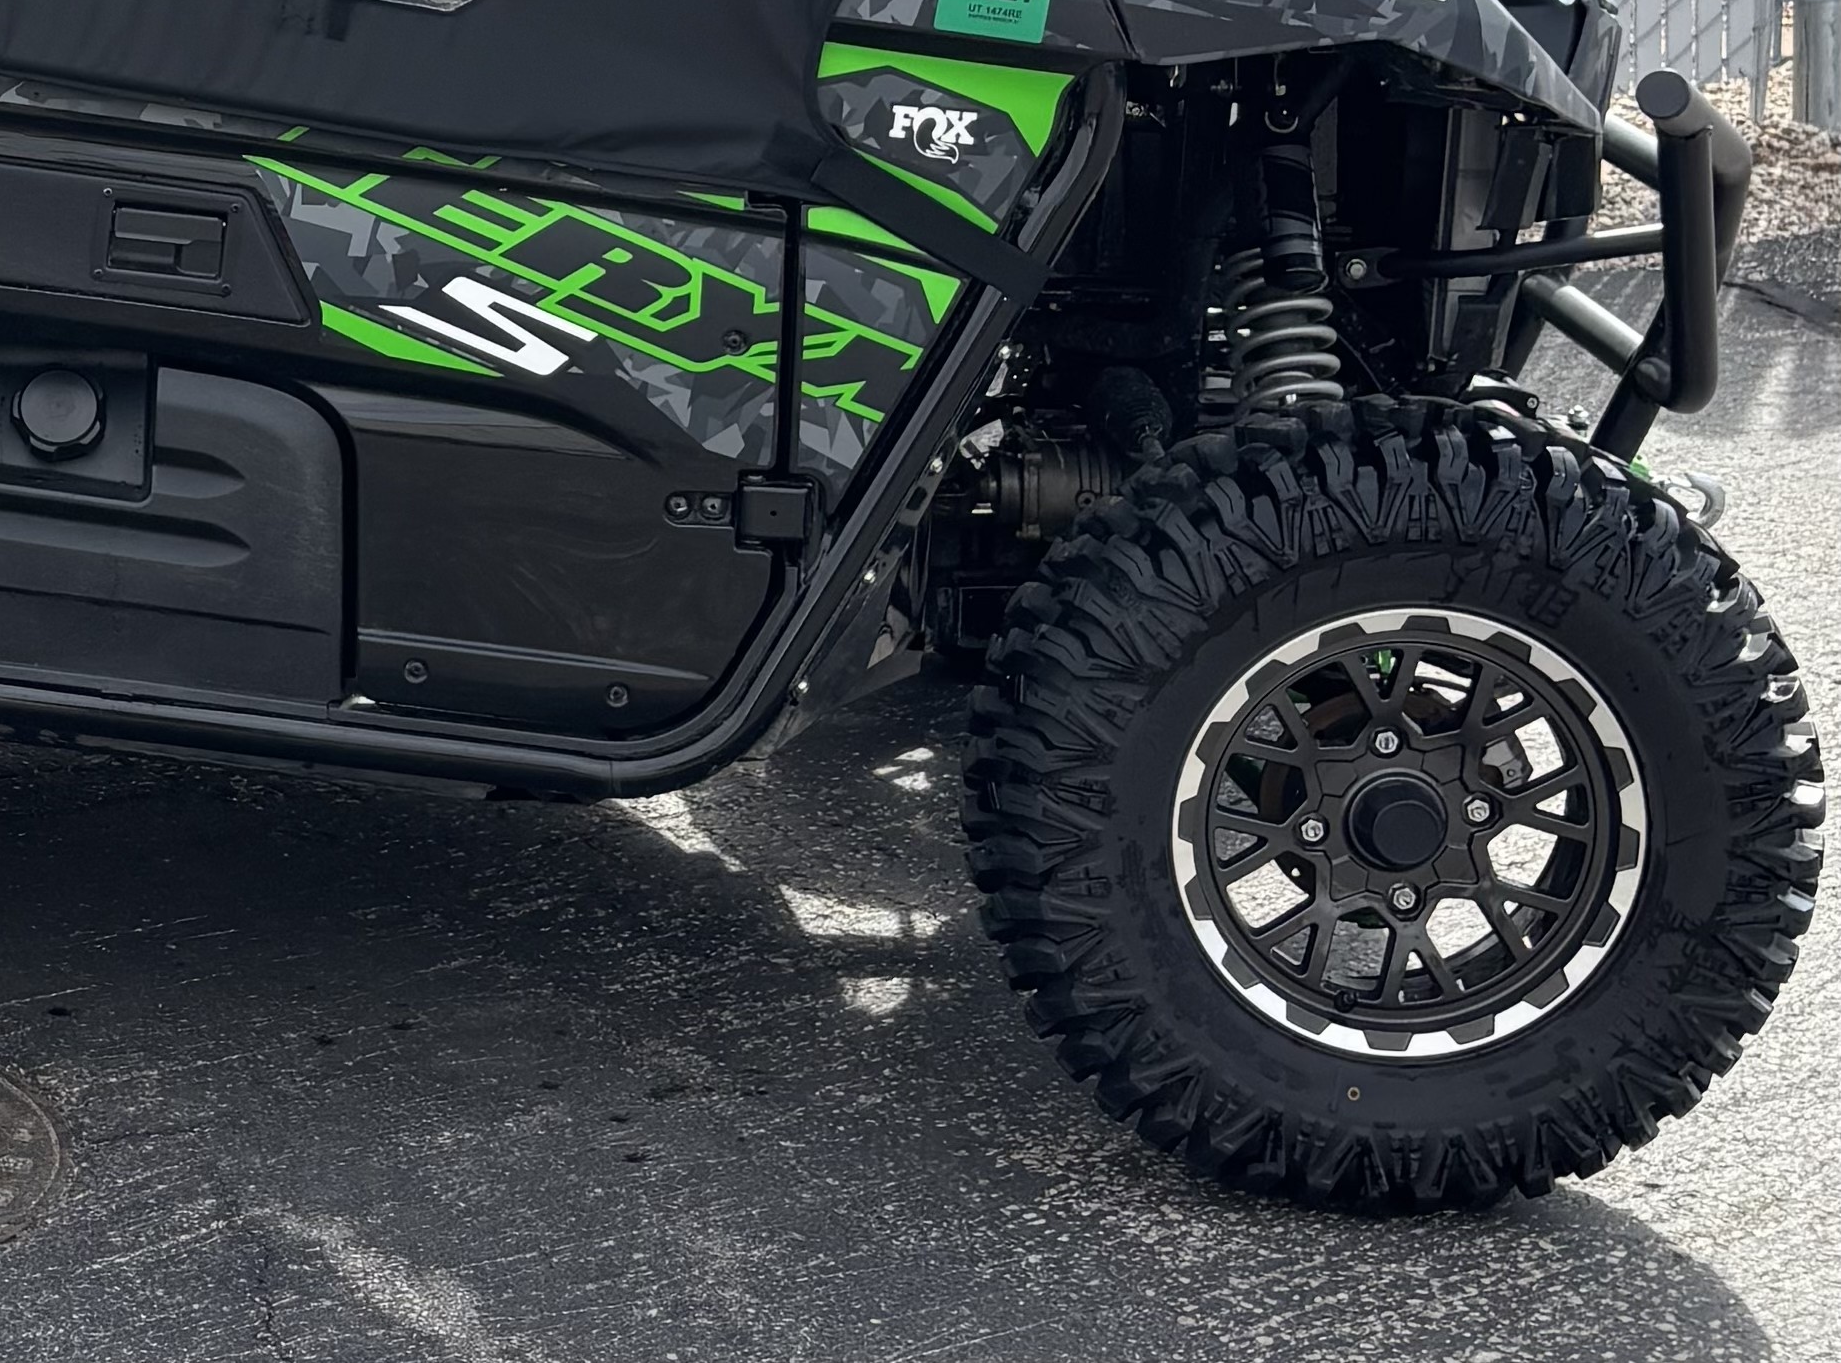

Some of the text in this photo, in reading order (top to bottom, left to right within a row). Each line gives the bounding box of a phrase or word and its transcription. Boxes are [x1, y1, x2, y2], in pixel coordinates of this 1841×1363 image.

[968, 3, 983, 13] UT
[888, 104, 978, 164] FOX
[379, 276, 598, 377] S
